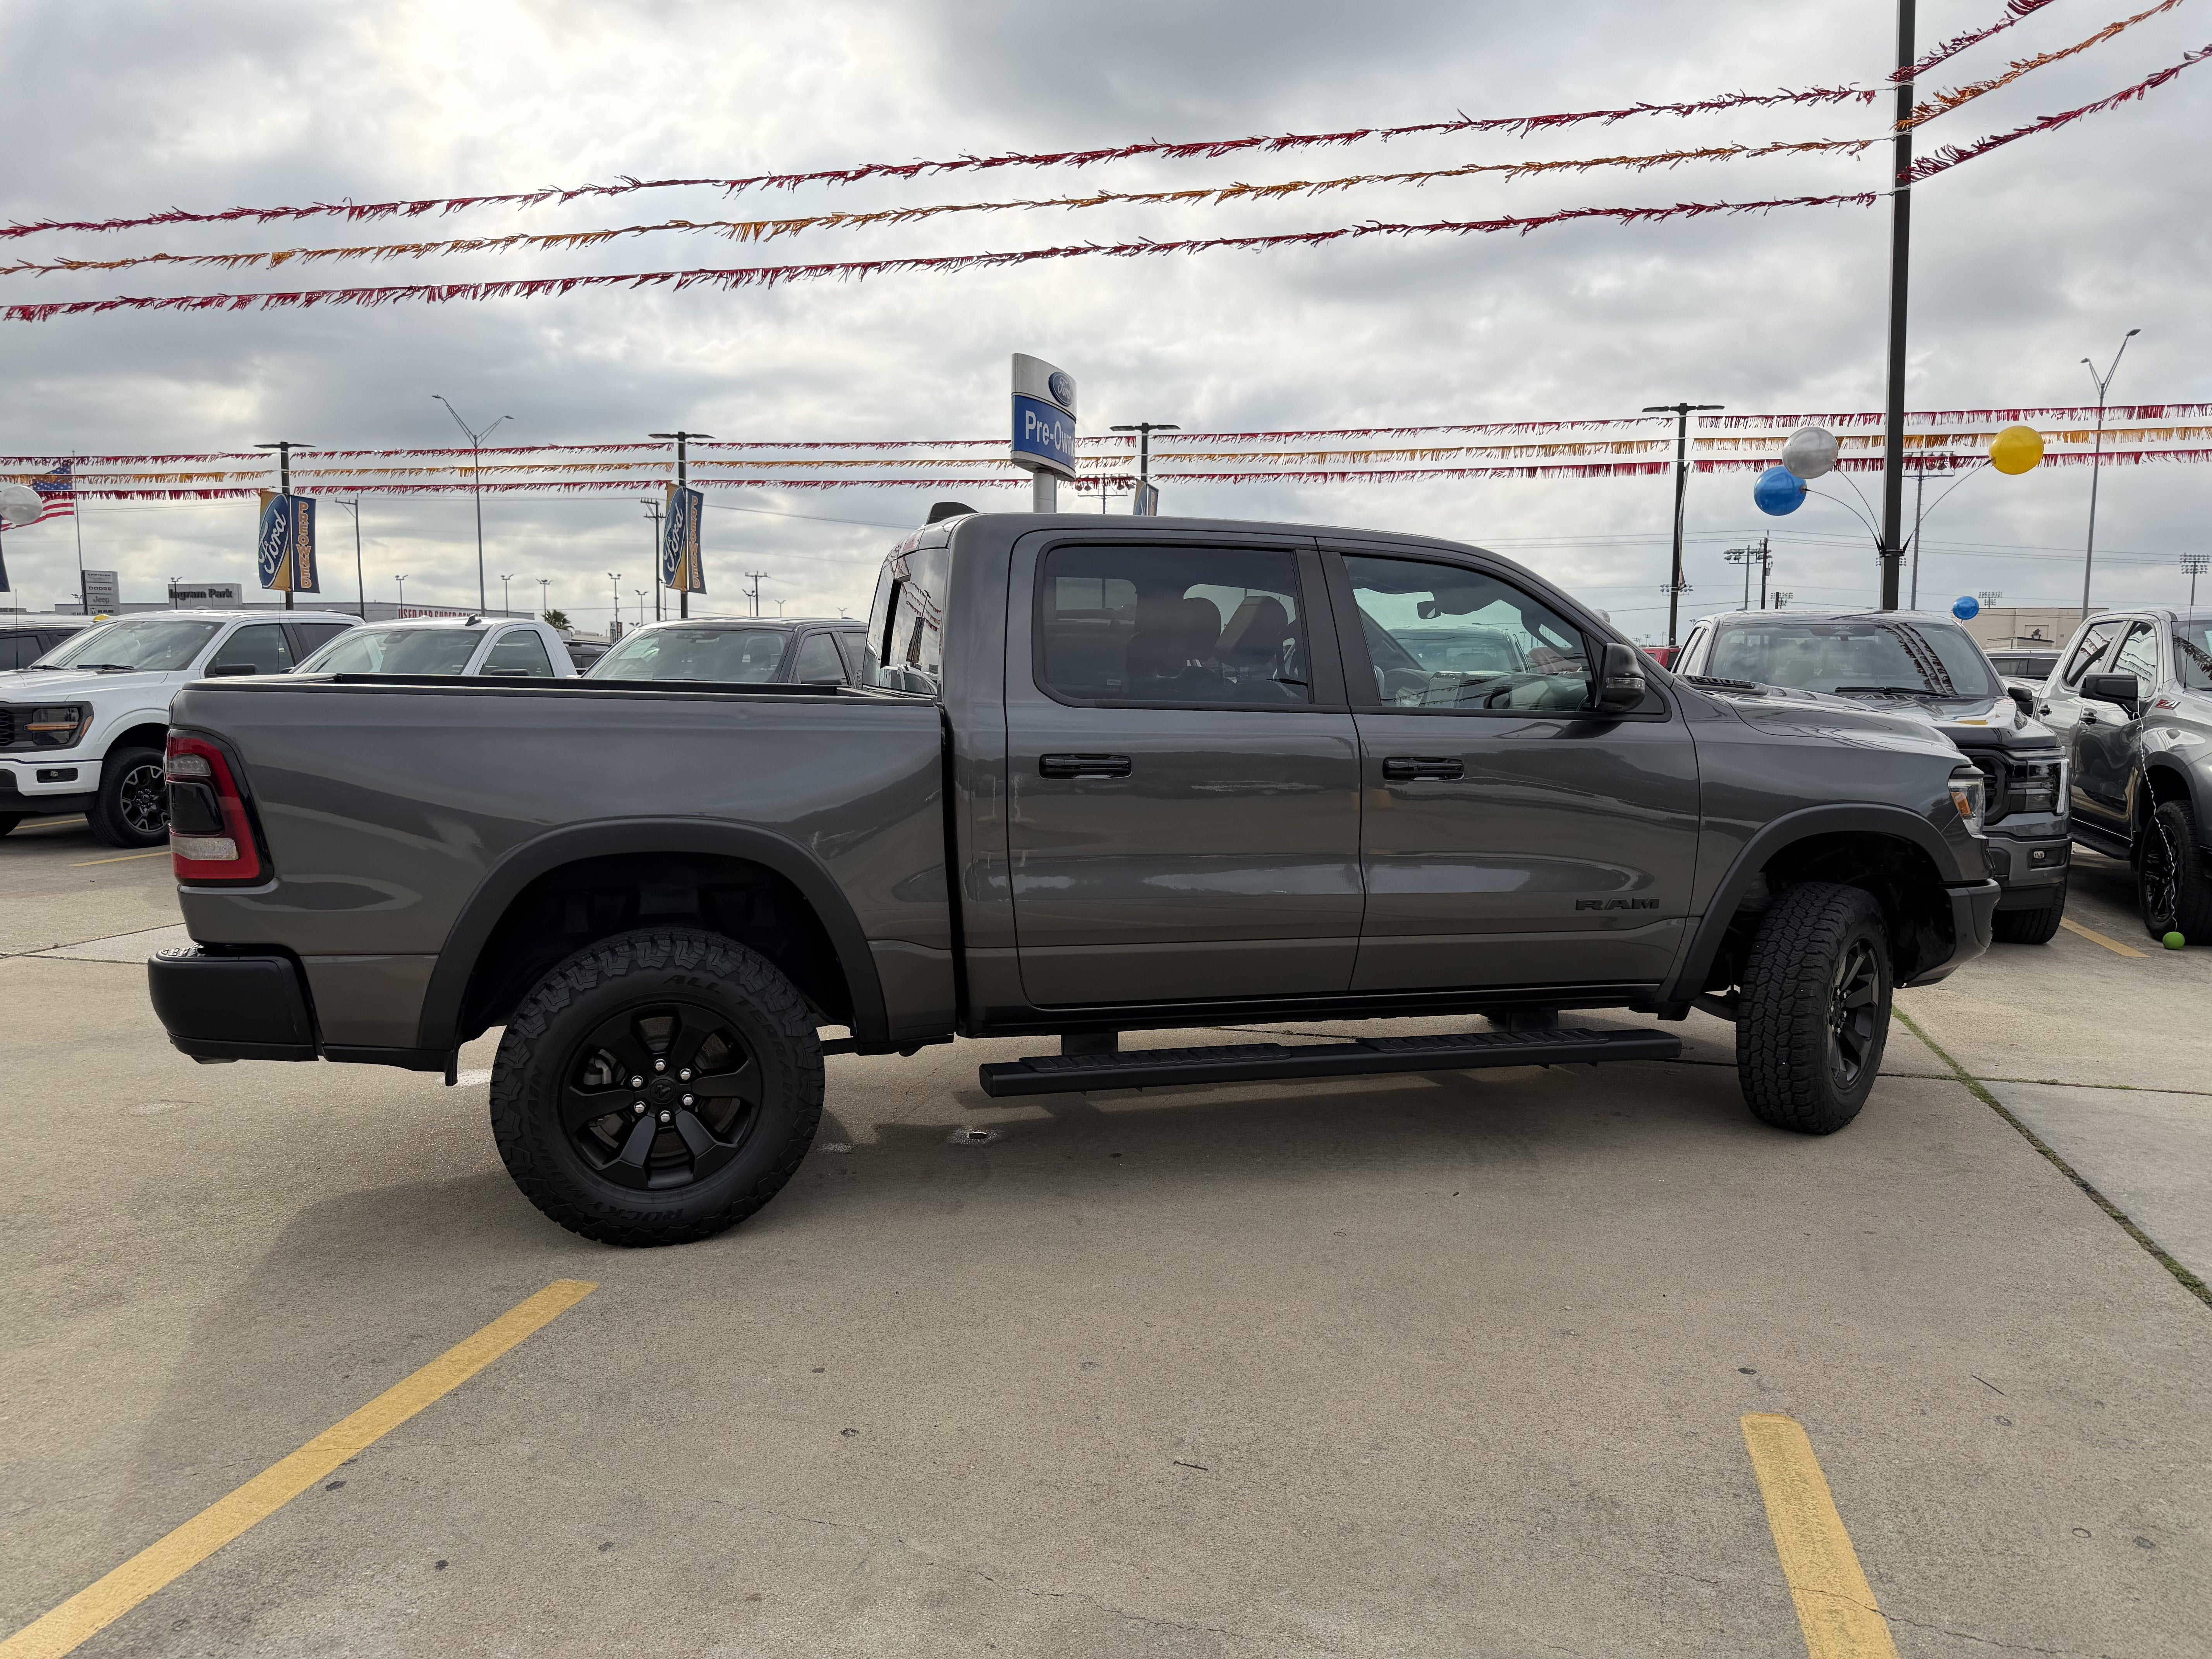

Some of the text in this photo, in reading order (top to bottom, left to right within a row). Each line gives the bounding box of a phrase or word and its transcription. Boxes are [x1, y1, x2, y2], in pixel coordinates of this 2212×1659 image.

[1058, 377, 1071, 399] Ford
[258, 508, 286, 574] Ford
[296, 501, 312, 588] PREOWNED
[663, 502, 683, 572] Ford
[93, 596, 110, 604] Jeep
[169, 589, 232, 600] Ingram Park
[398, 609, 417, 619] USED
[1686, 676, 1735, 685] 1500
[1575, 898, 1660, 910] RAM
[663, 974, 722, 994] ALL
